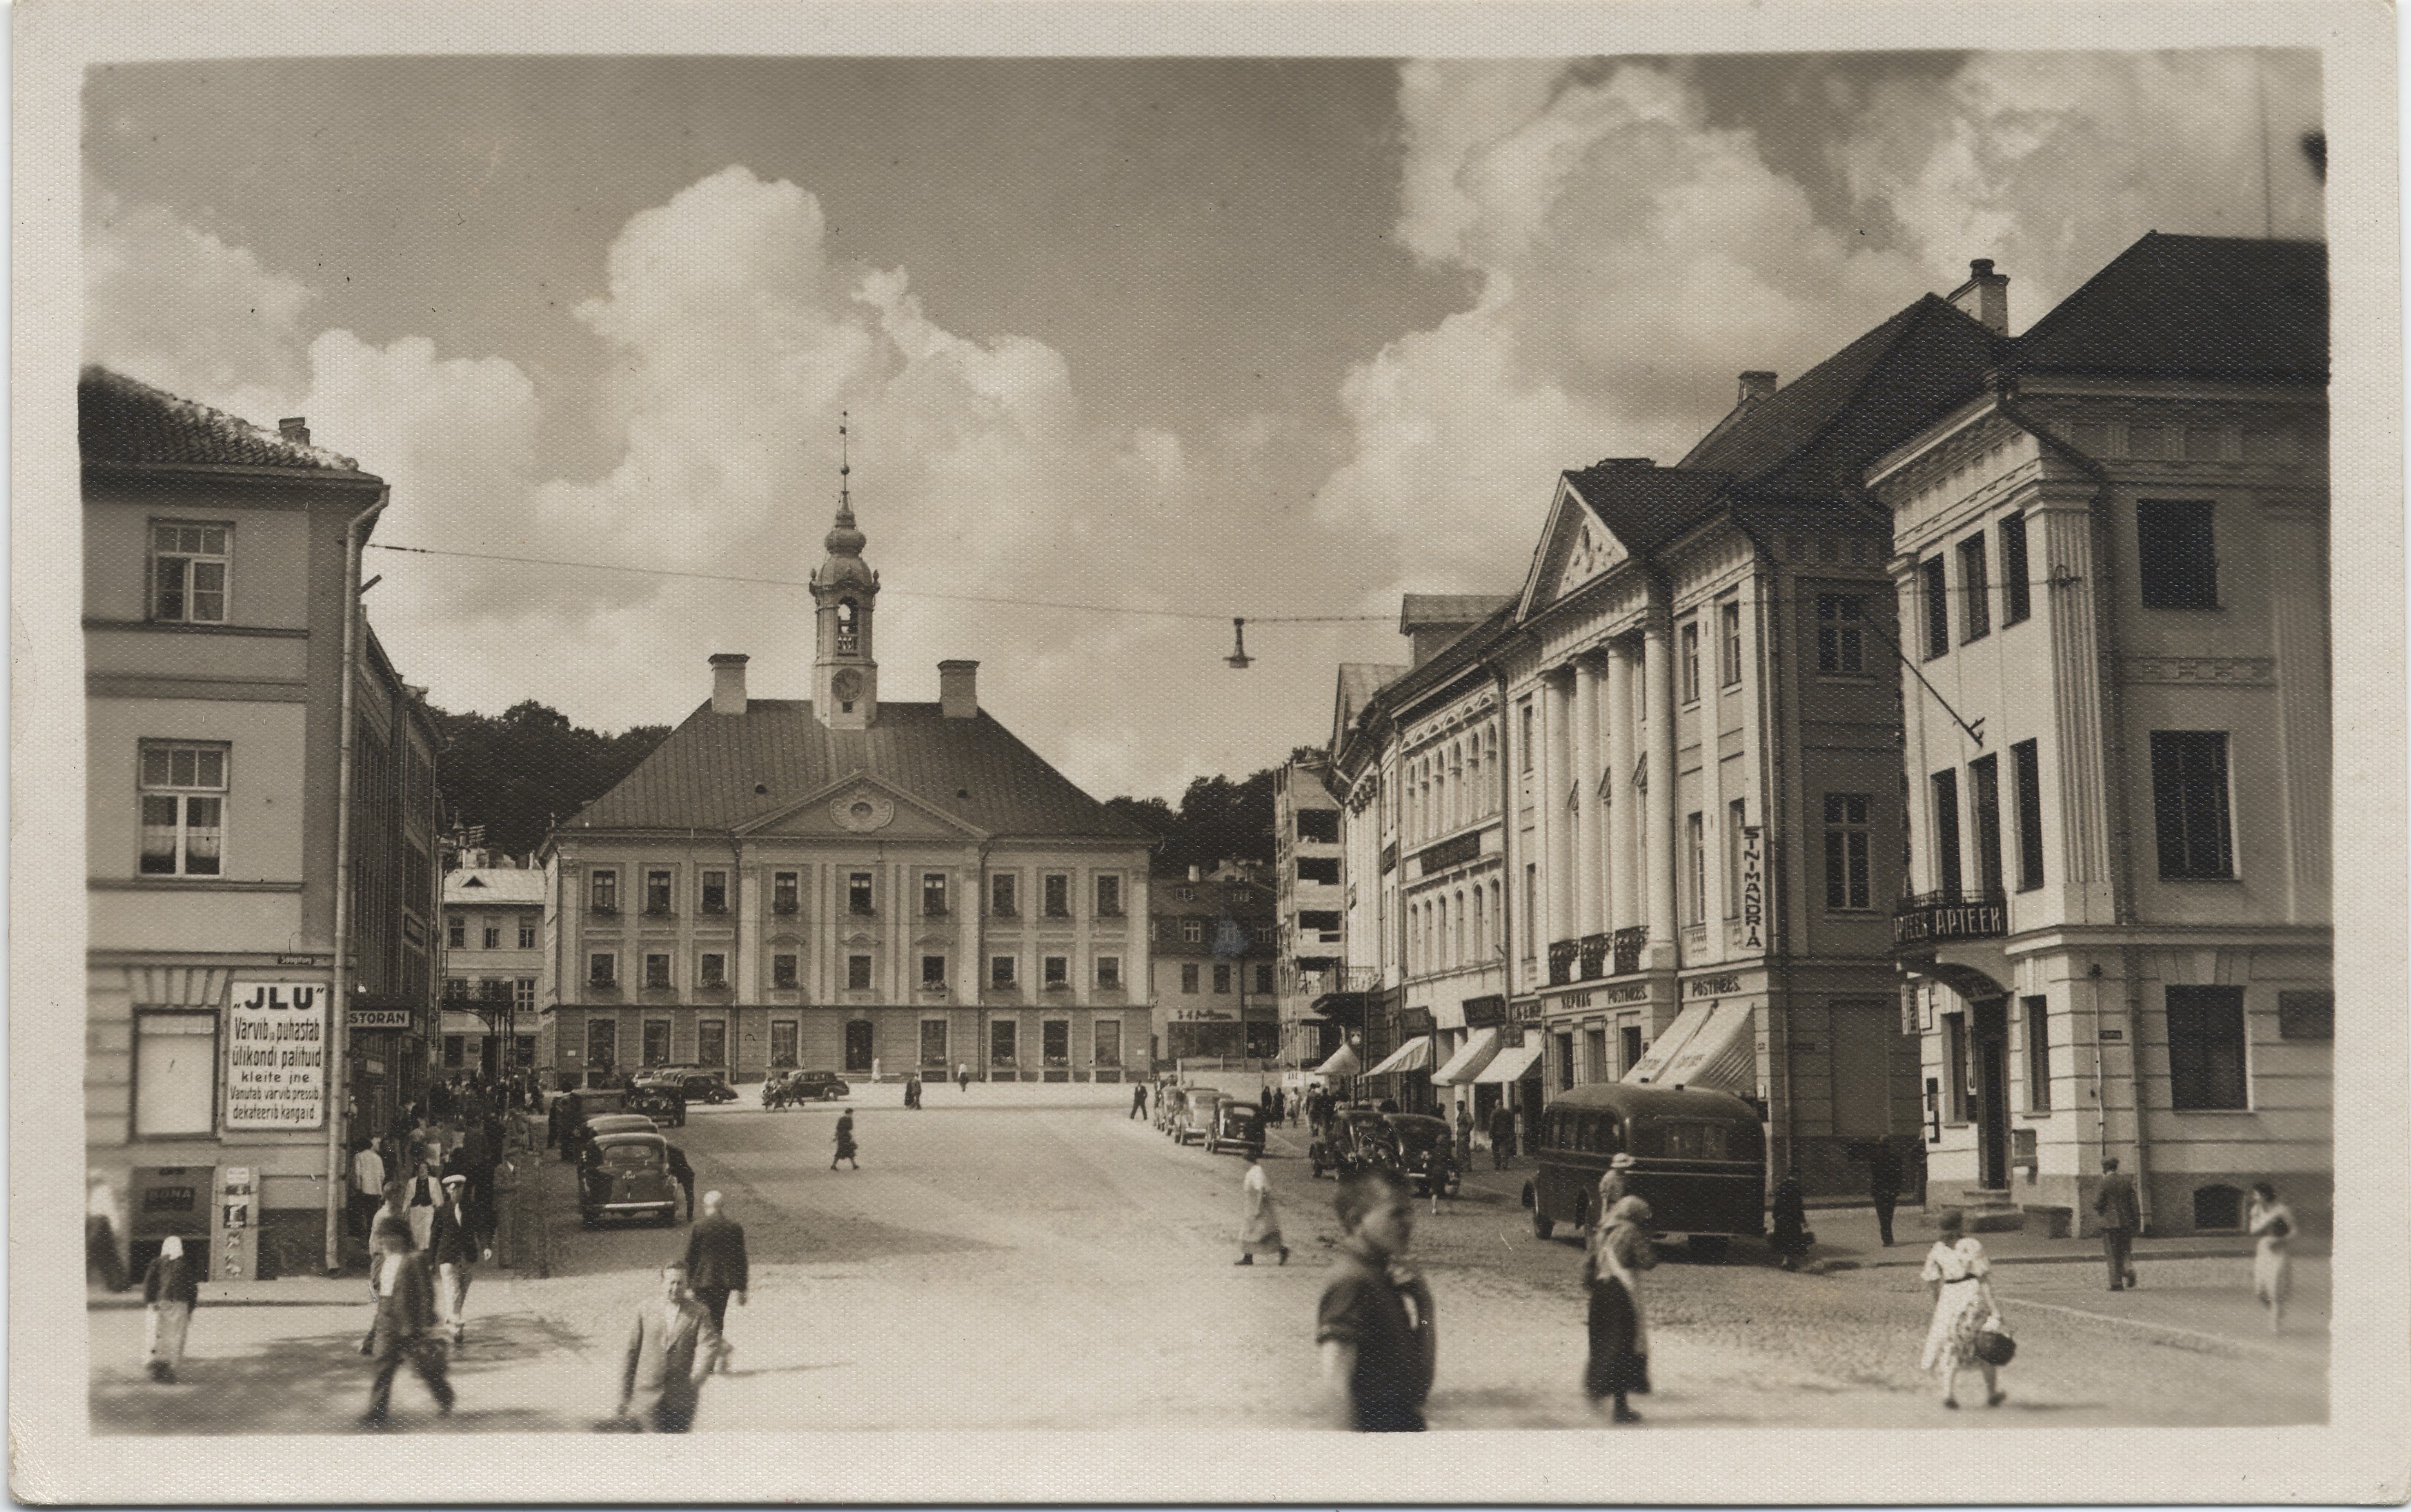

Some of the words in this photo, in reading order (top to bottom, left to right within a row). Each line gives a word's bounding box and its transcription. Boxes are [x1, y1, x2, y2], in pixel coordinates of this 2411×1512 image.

[1744, 829, 1761, 948] SINIMANDRIA
[1935, 907, 2001, 935] APTEEK
[234, 1017, 268, 1040] Värvib
[277, 1017, 320, 1043] puhastab
[242, 1070, 281, 1083] kleite
[289, 1071, 309, 1084] jne
[233, 1104, 278, 1119] dekateerib
